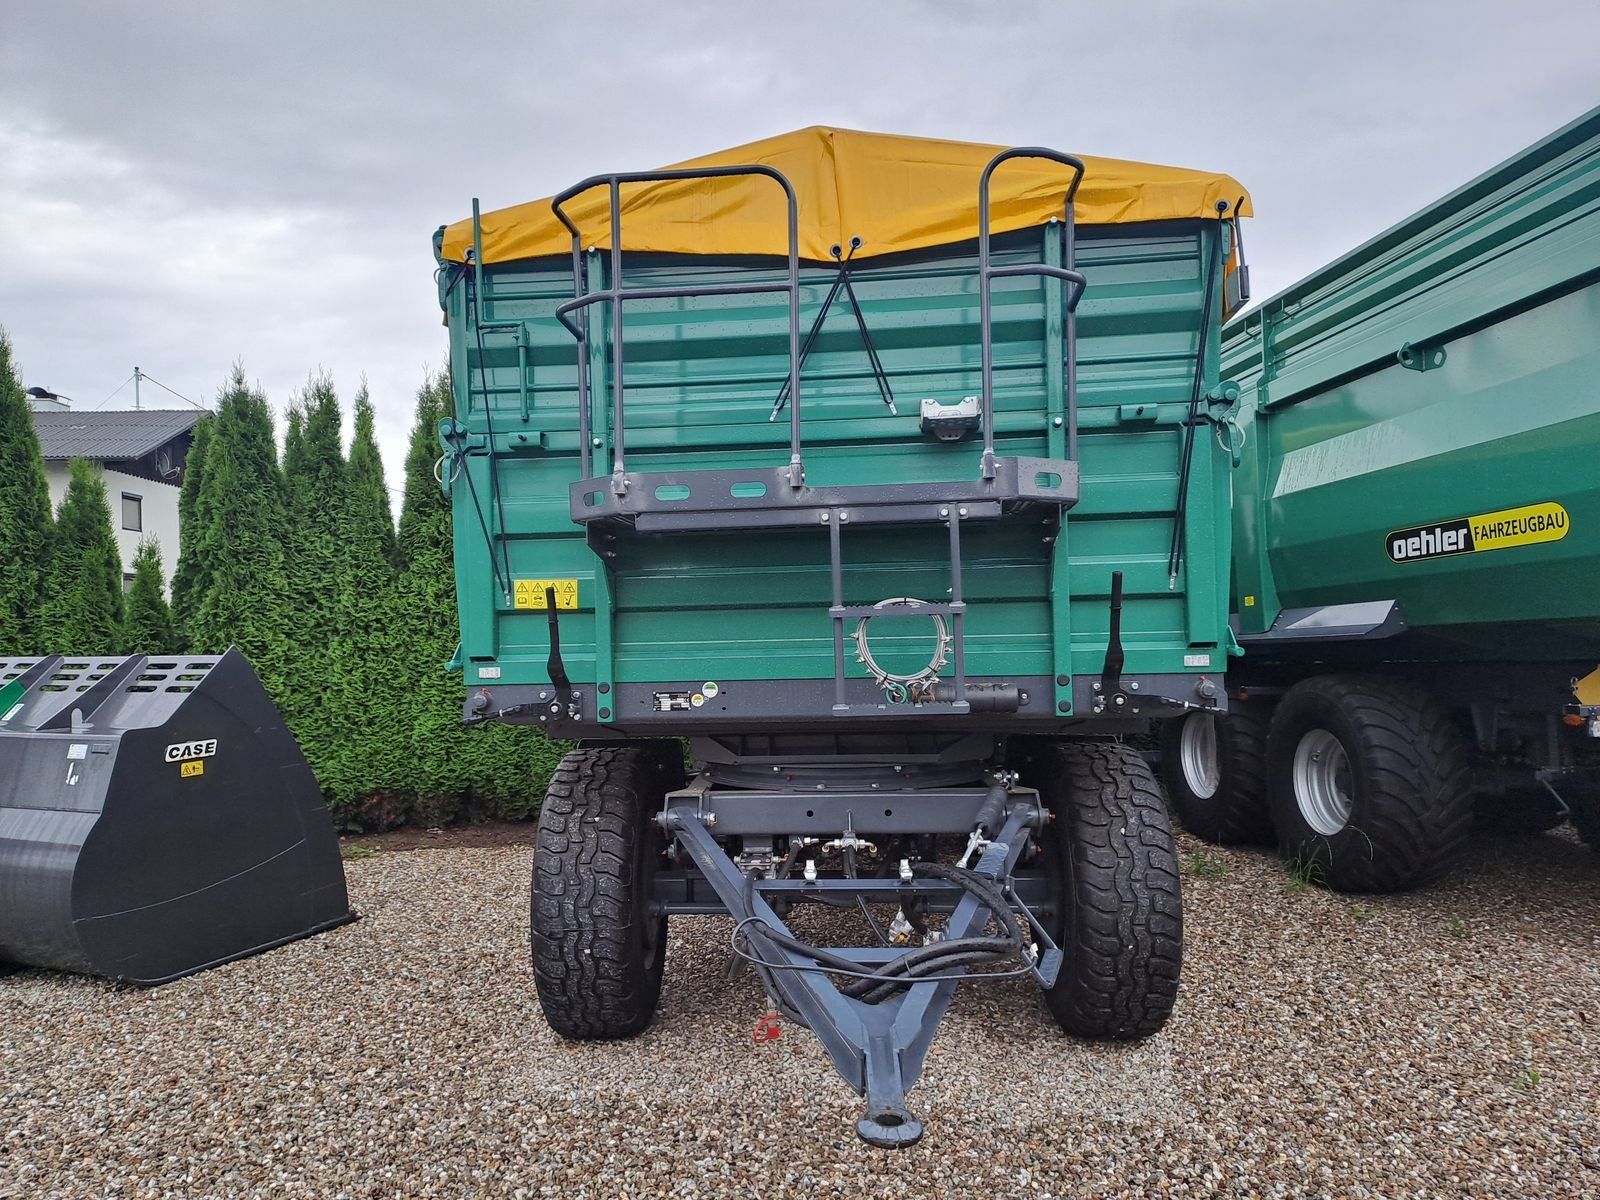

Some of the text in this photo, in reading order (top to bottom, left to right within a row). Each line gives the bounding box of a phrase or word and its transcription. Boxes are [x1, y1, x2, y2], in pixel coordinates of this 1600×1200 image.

[1393, 511, 1566, 560] oehler FAHRZEUGBAU
[168, 741, 215, 759] CASE
